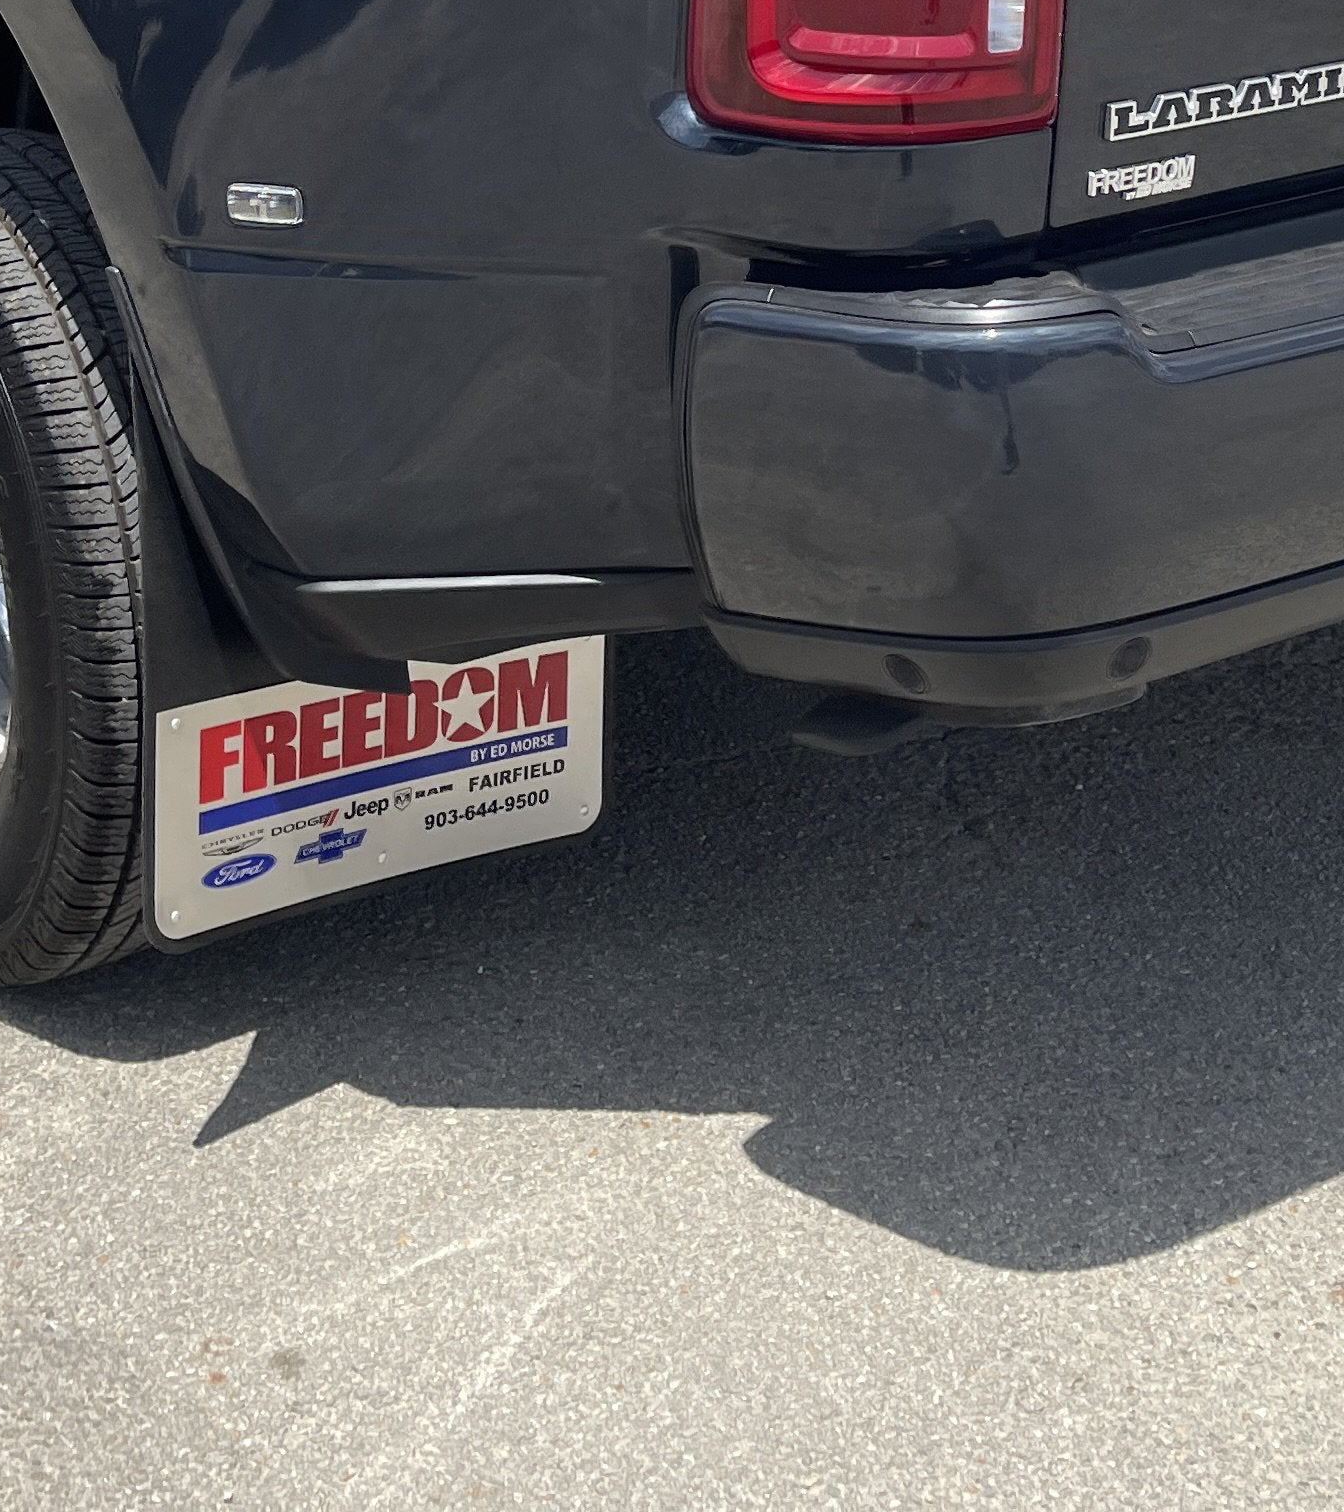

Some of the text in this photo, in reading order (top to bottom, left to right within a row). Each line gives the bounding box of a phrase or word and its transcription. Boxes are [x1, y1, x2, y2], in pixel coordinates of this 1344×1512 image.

[1087, 154, 1196, 197] FREEDOM
[199, 650, 569, 804] FREEDOM
[470, 733, 556, 763] BY ED MORSE
[469, 758, 566, 792] FAIRFIELD
[271, 813, 329, 837] DODGE
[344, 796, 389, 821] Jeep
[415, 783, 454, 799] RAM
[424, 788, 550, 830] 903-644-9500
[302, 834, 360, 857] CHEVROLET
[214, 859, 265, 886] Ford
